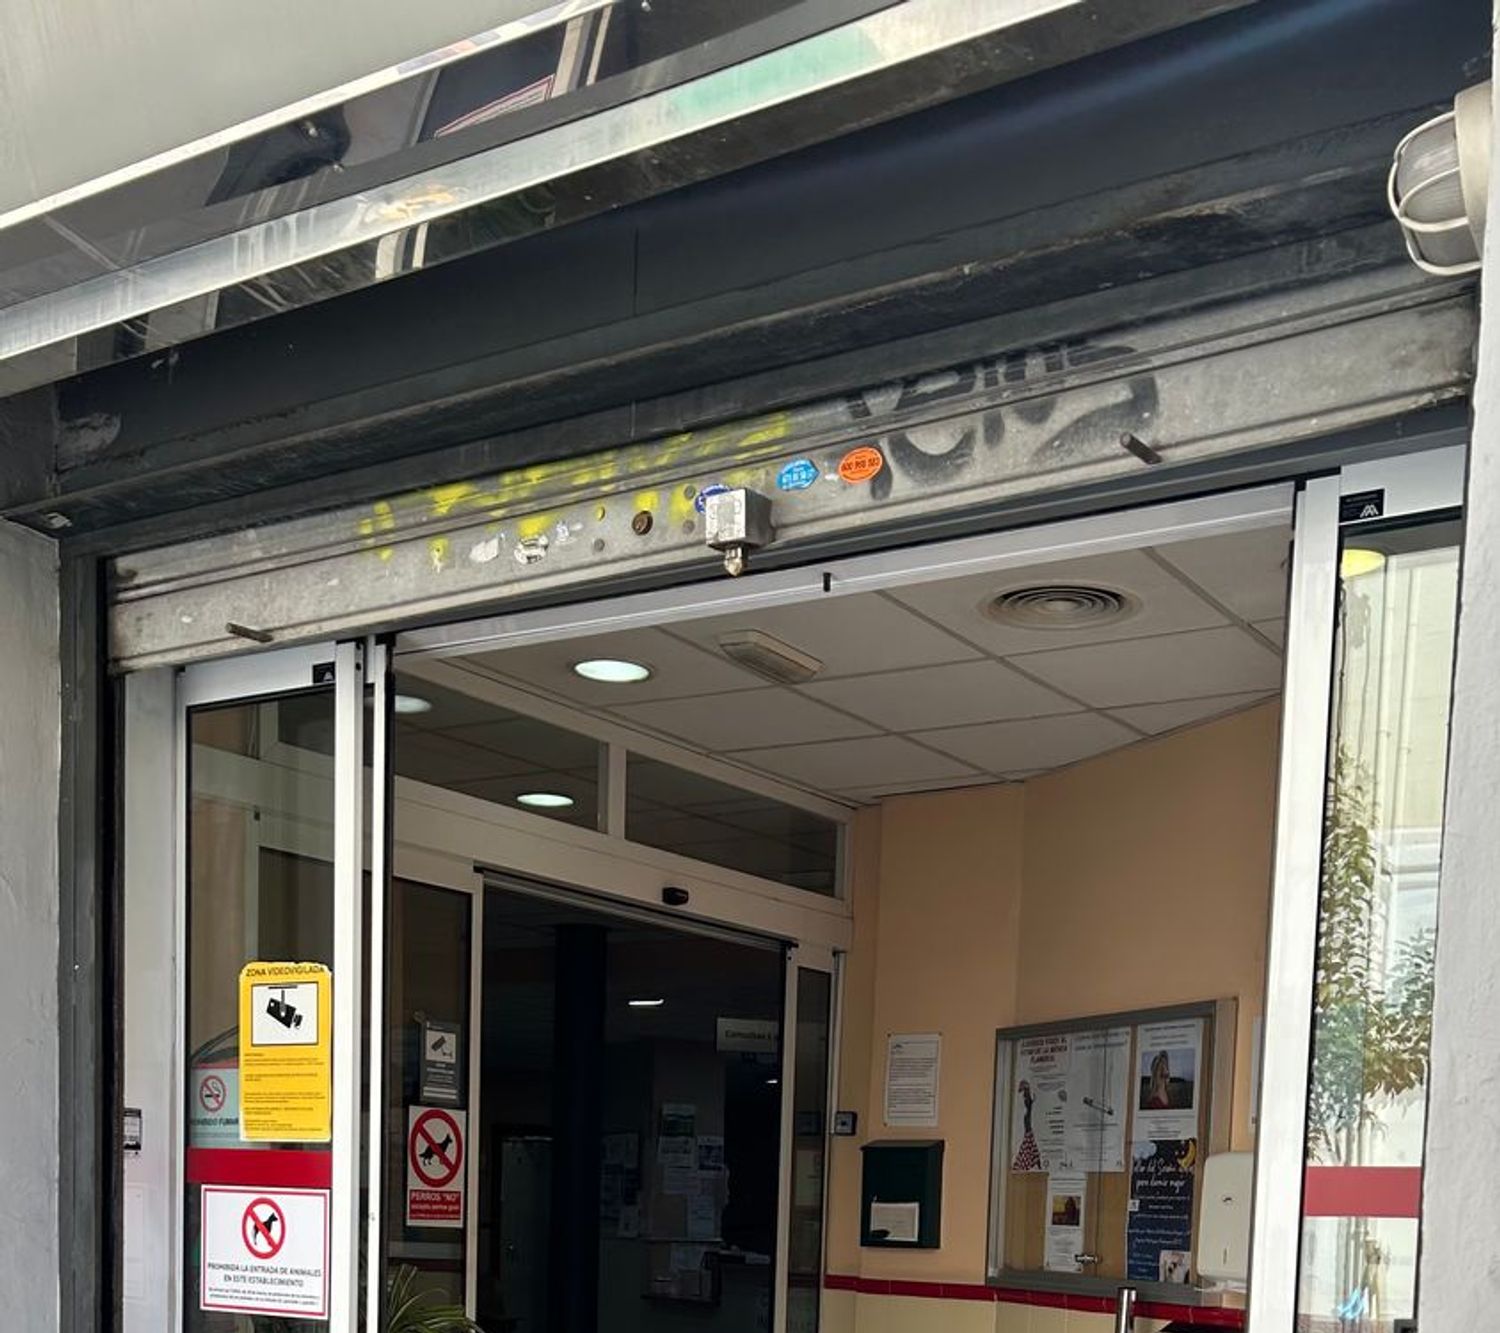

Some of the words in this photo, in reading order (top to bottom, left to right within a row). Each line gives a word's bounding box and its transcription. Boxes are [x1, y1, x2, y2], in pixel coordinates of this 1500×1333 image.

[208, 1263, 240, 1272] PROHIBIDA
[250, 1265, 279, 1274] ENTRADA
[280, 1267, 288, 1275] DE
[289, 1267, 322, 1277] ANIMALES
[224, 1274, 232, 1283] EN
[233, 1275, 247, 1284] ESTE
